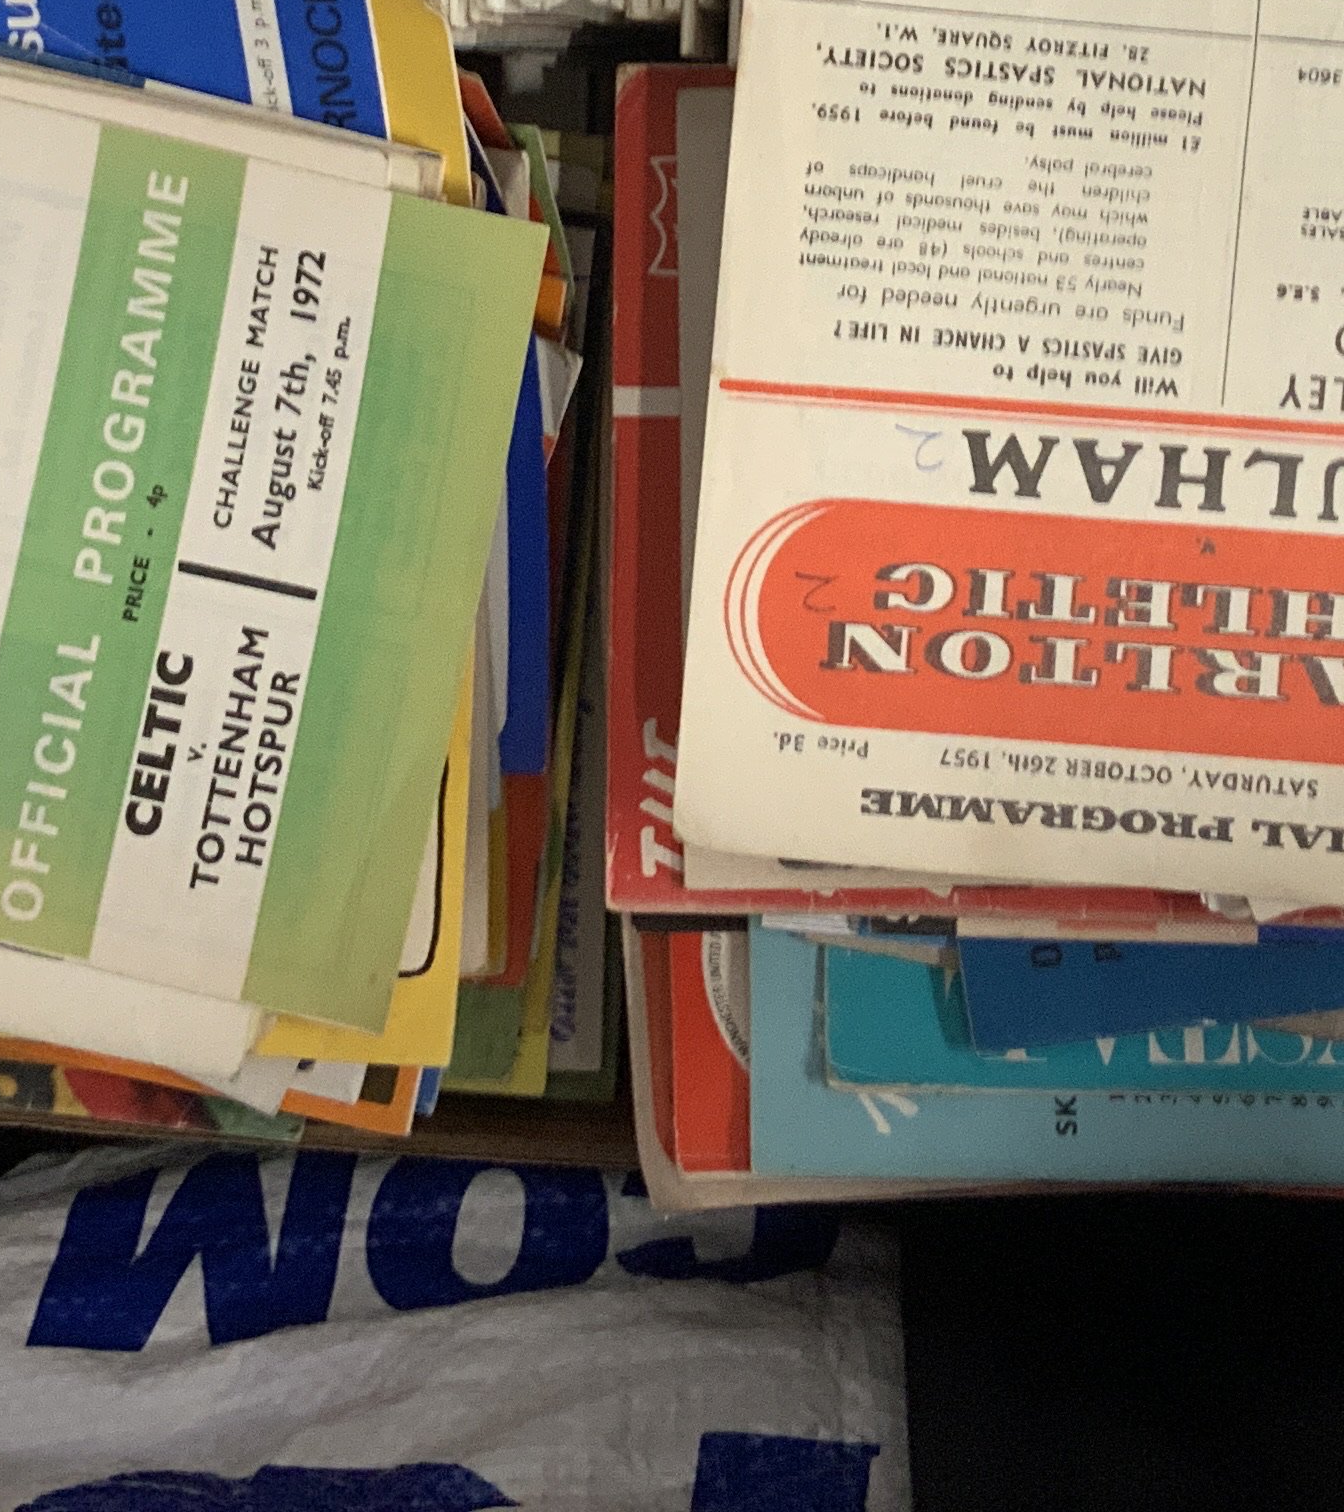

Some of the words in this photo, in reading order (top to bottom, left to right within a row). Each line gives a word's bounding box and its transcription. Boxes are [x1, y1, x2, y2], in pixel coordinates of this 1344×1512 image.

[815, 41, 925, 75] SOCIETY,
[943, 55, 1056, 87] SPASTICS
[1074, 67, 1207, 99] NATIONAL
[1296, 65, 1344, 87] 3604
[796, 250, 884, 274] treatment
[889, 259, 932, 281] local
[936, 262, 972, 282] and
[975, 267, 1049, 287] national
[288, 248, 327, 324] 1972
[1083, 273, 1143, 299] Nearly
[1274, 281, 1321, 304] S.E.6
[332, 314, 352, 361] p.m.
[832, 318, 889, 343] LIFE?
[898, 323, 921, 344] IN
[931, 326, 1007, 352] CHANCE
[1016, 333, 1031, 355] A
[1040, 336, 1126, 361] SPASTICS
[1136, 344, 1183, 366] GIVE
[211, 357, 261, 531] CHALLENGE
[243, 243, 280, 349] MATCH
[272, 351, 318, 417] 7th,
[319, 365, 343, 406] 7.45
[305, 410, 336, 492] Kick-off
[249, 425, 298, 552] August
[0, 628, 101, 922] OFFICIAL
[71, 169, 189, 584] PROGRAMME
[119, 552, 152, 624] PRICE
[144, 482, 169, 510] 4p
[120, 648, 194, 838] CELTIC
[187, 623, 270, 890] TOTTENHAM
[771, 730, 806, 754] 3d.
[815, 733, 870, 761] Price
[233, 669, 302, 868] HOTSPUR
[938, 746, 991, 771] 1957
[1000, 749, 1058, 777] 26th,
[1064, 756, 1174, 786] OCTOBER
[1180, 764, 1319, 801] SATURDAY,
[858, 785, 1236, 844] PROGRAMME
